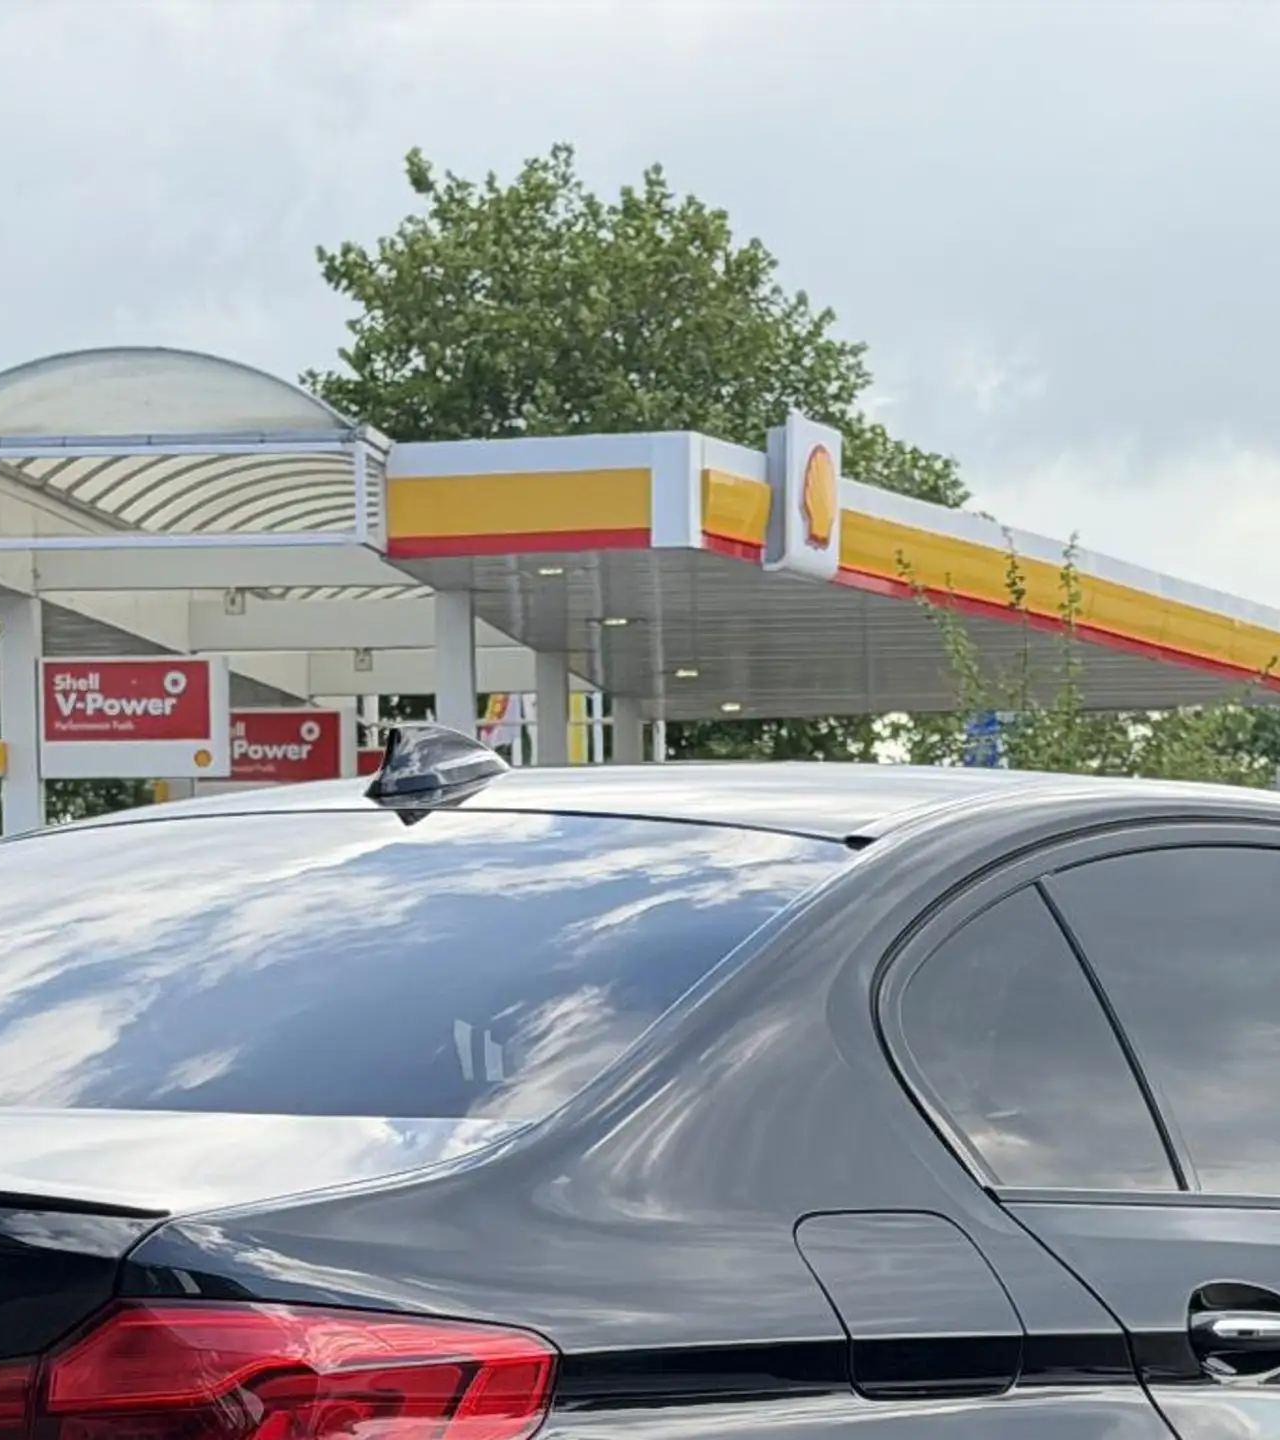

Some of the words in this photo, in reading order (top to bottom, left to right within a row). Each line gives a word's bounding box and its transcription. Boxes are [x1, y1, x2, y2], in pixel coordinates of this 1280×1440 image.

[53, 672, 100, 691] Shell
[55, 692, 178, 716] V-Power
[232, 740, 313, 760] Power
